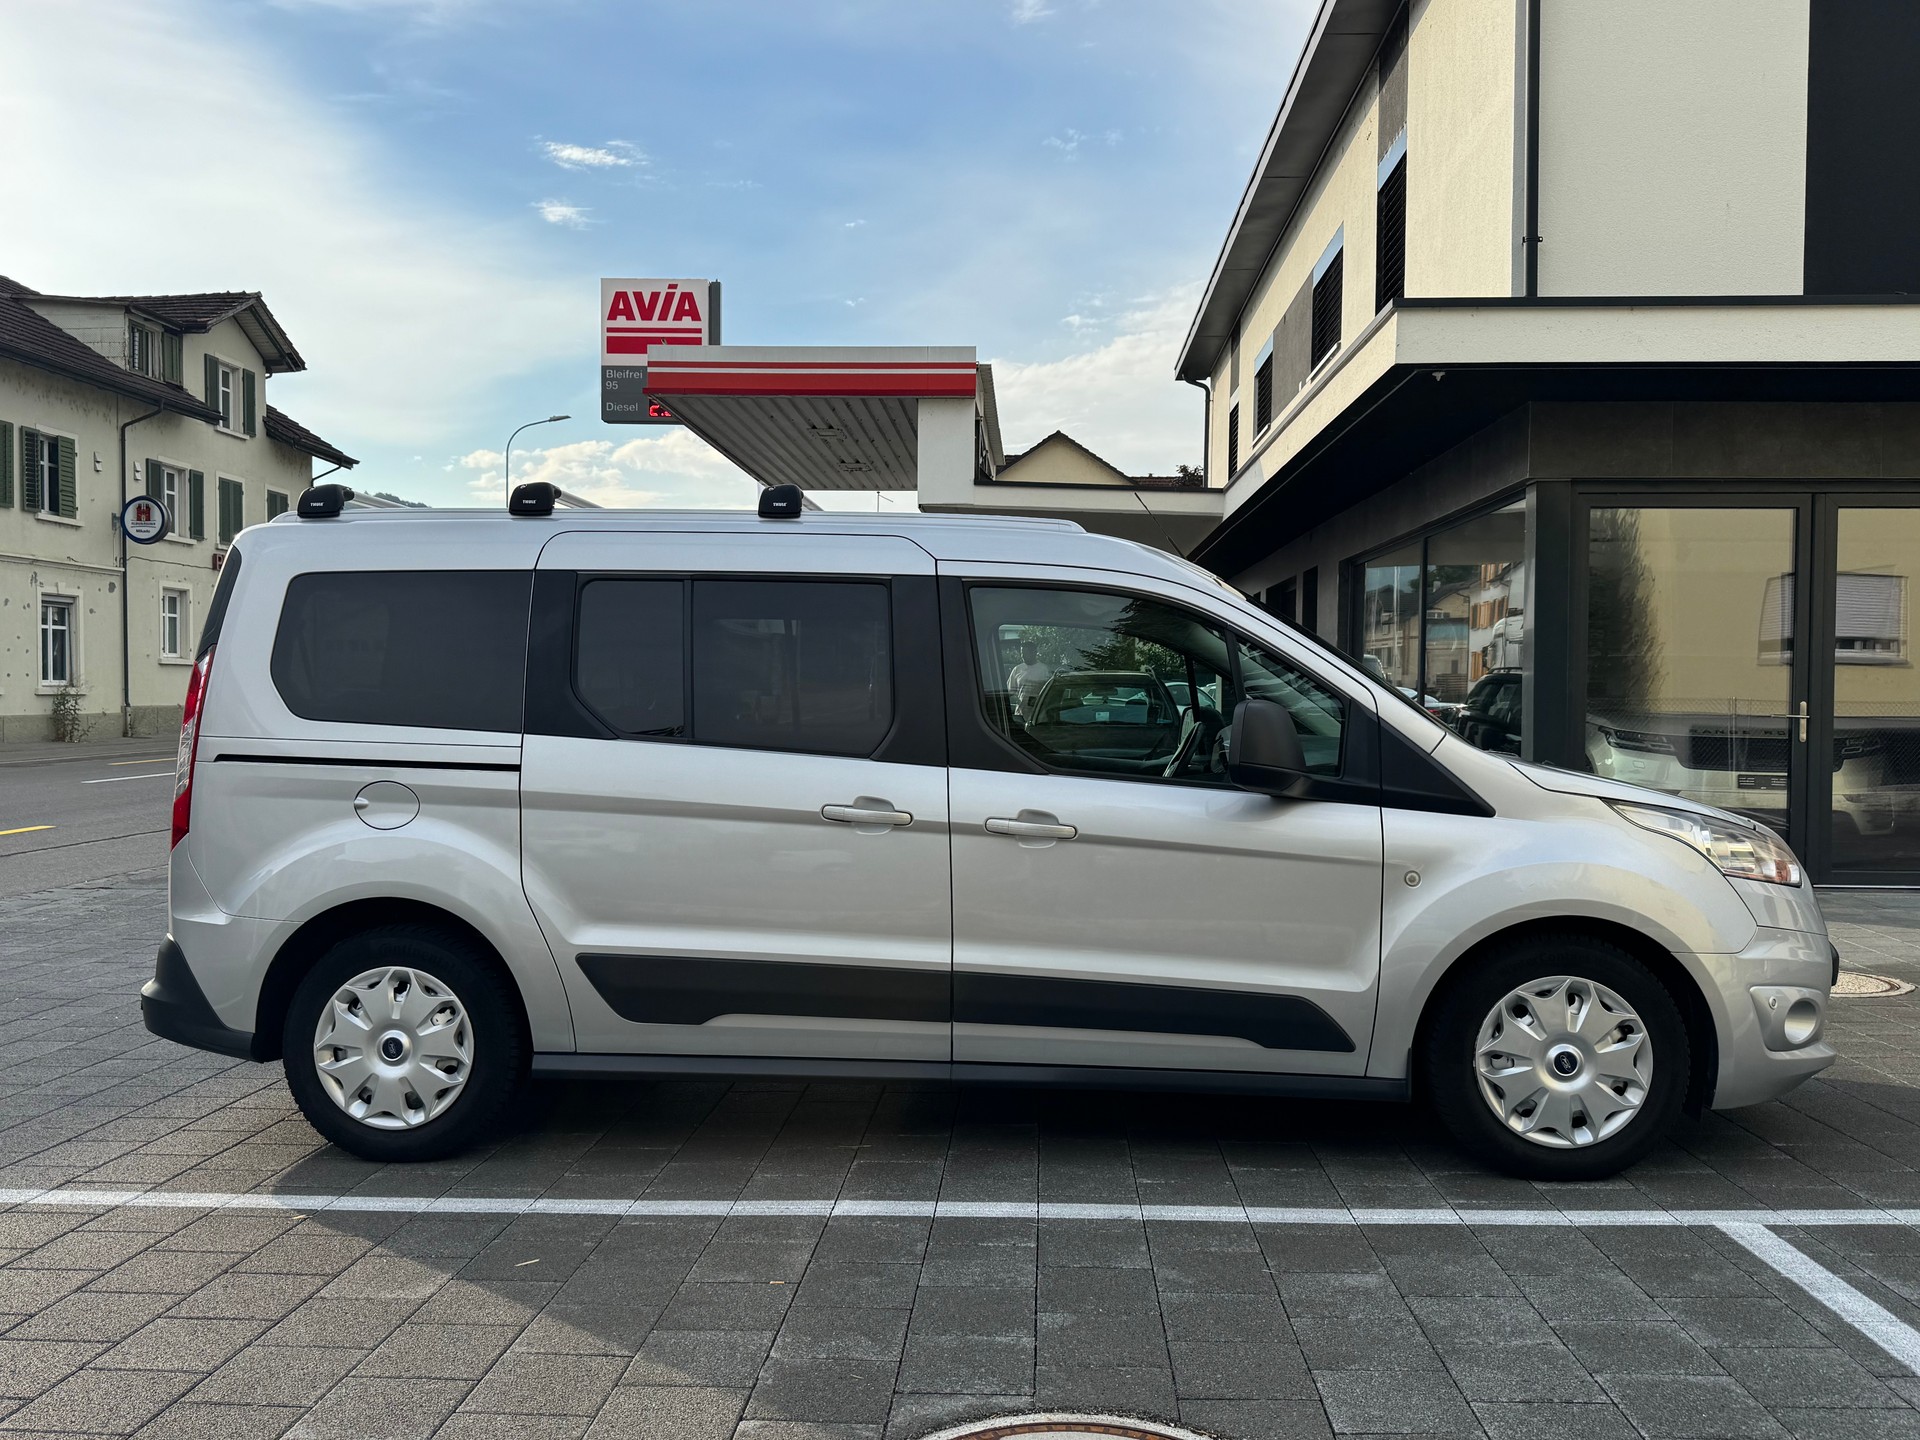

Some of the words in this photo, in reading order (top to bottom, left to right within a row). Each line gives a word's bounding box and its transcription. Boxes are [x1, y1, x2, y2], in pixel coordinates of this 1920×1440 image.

[606, 370, 643, 379] Bleifrei
[606, 381, 619, 390] 95
[606, 402, 639, 412] Diesel
